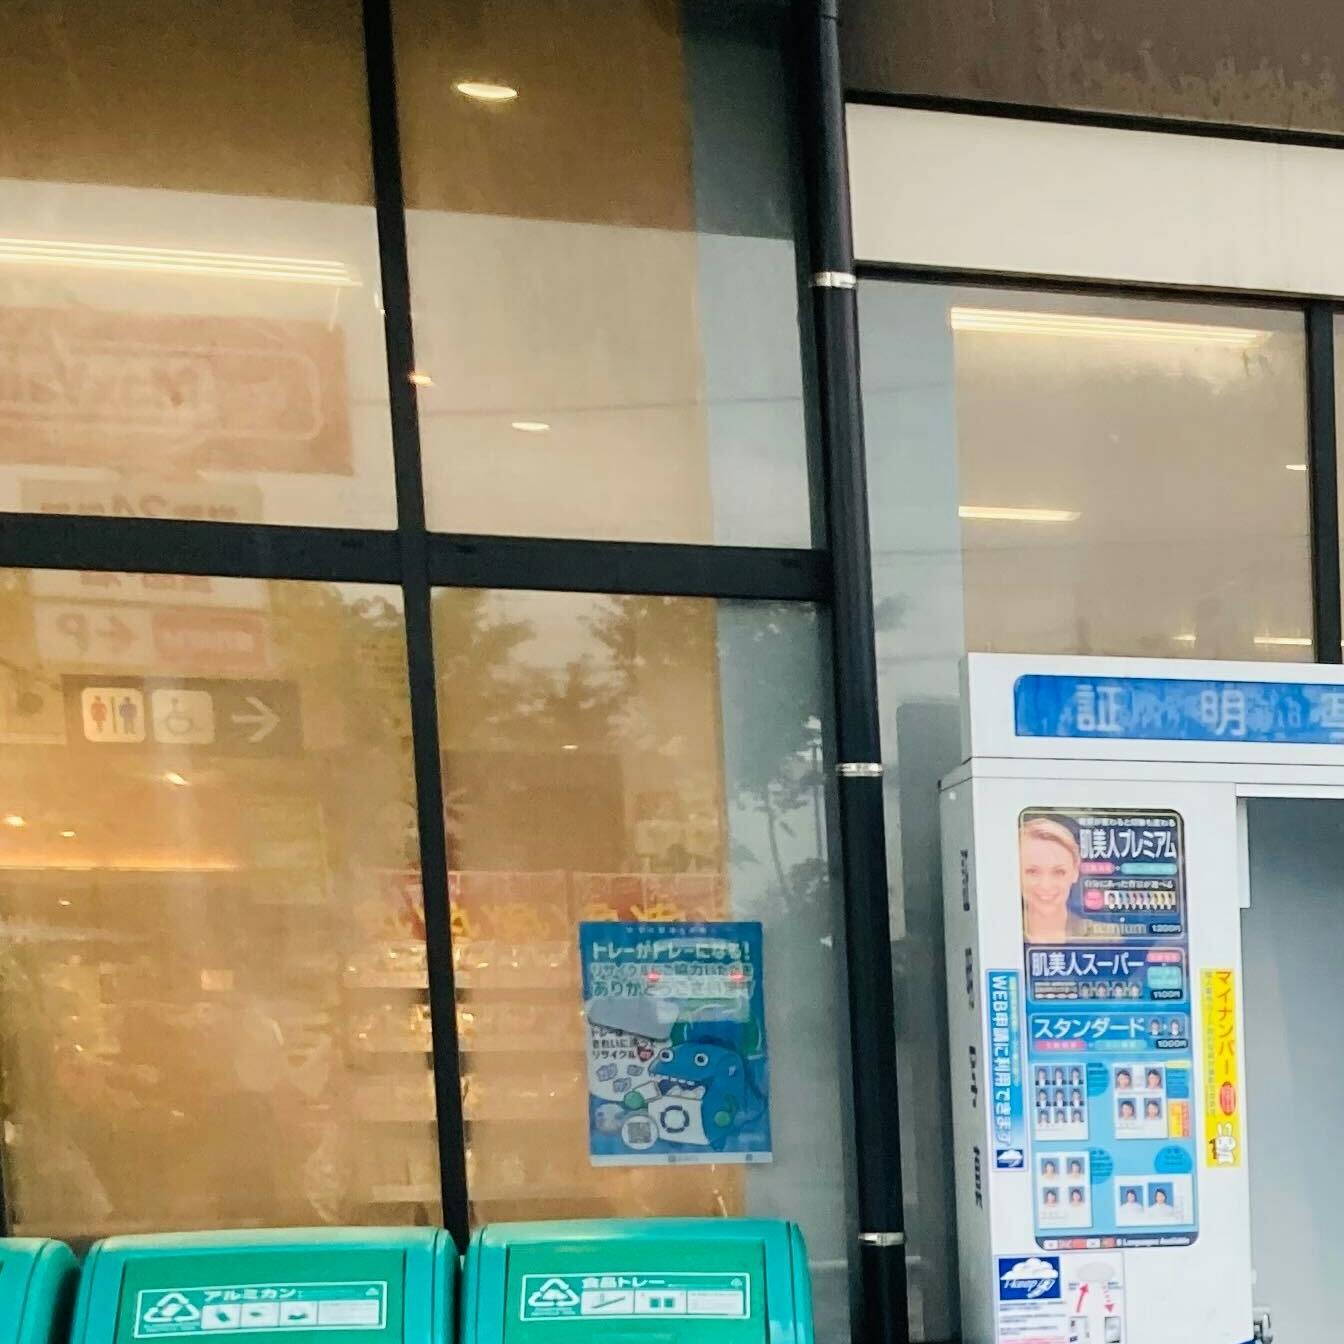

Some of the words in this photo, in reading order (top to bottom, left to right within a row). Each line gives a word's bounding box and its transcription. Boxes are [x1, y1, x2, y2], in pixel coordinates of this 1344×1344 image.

[1079, 828, 1177, 859] 肌美人プレミアム
[1032, 951, 1145, 977] 肌美人スーパー
[1033, 1017, 1145, 1039] スタンダード
[1215, 970, 1236, 1075] マイナンバー
